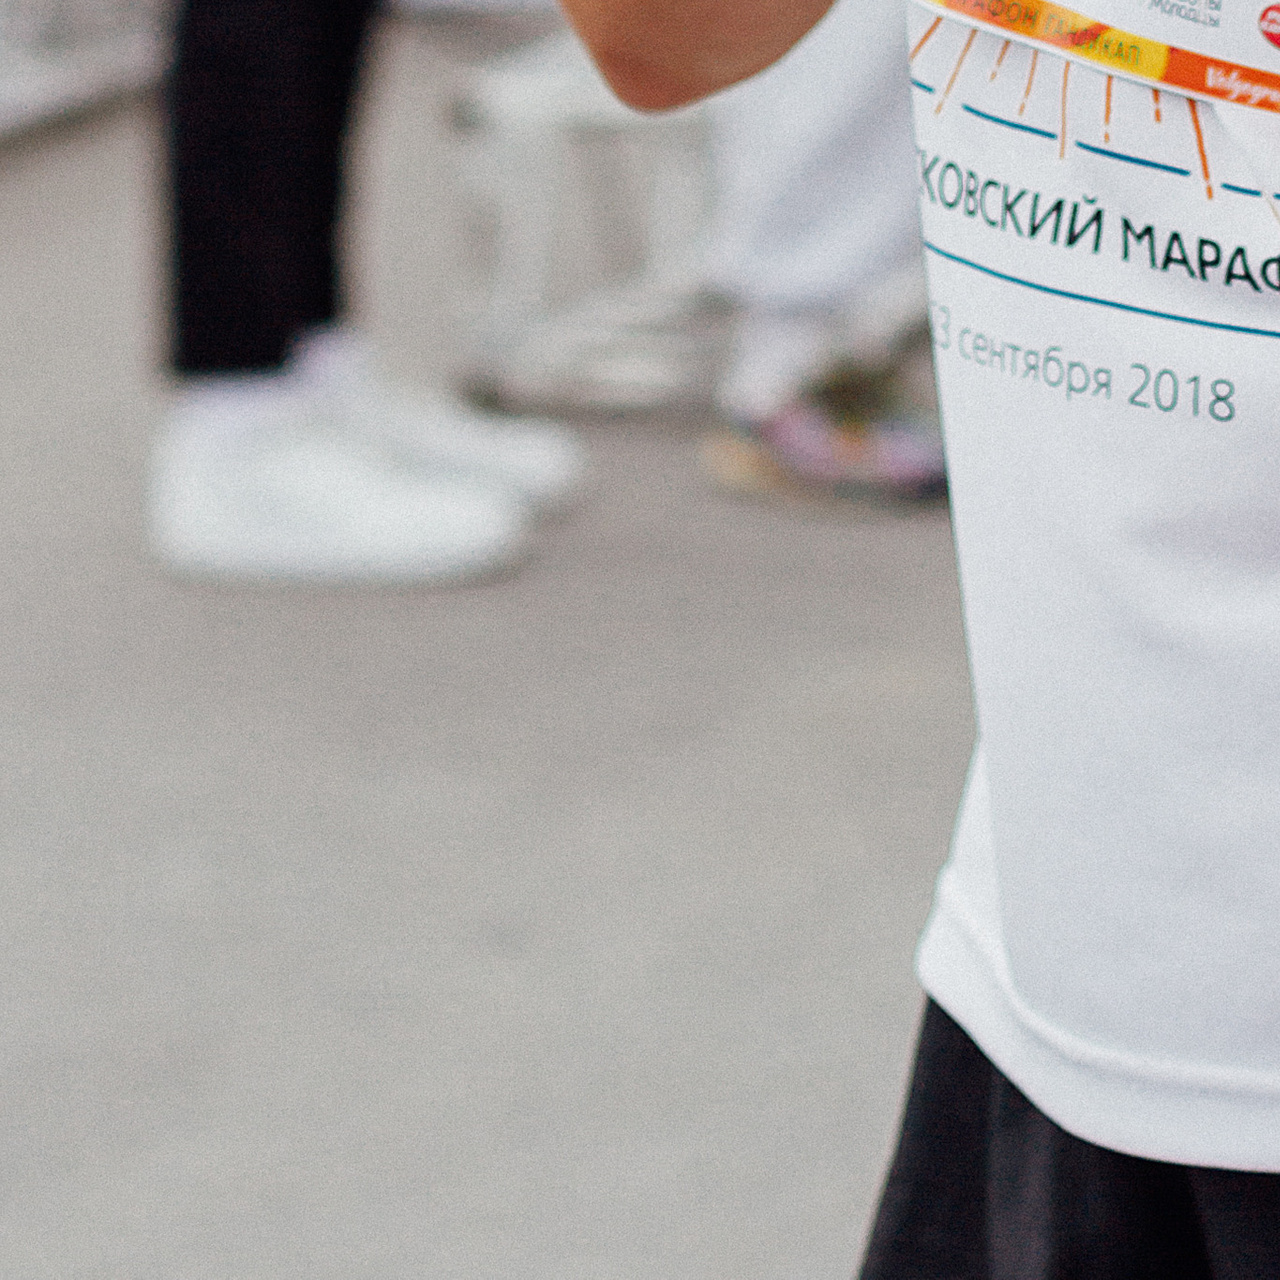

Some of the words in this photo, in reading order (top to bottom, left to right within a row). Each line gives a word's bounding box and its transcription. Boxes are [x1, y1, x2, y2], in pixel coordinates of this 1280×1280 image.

[931, 302, 951, 350] 3
[958, 325, 1113, 401] сентября
[1128, 362, 1236, 423] 2018
